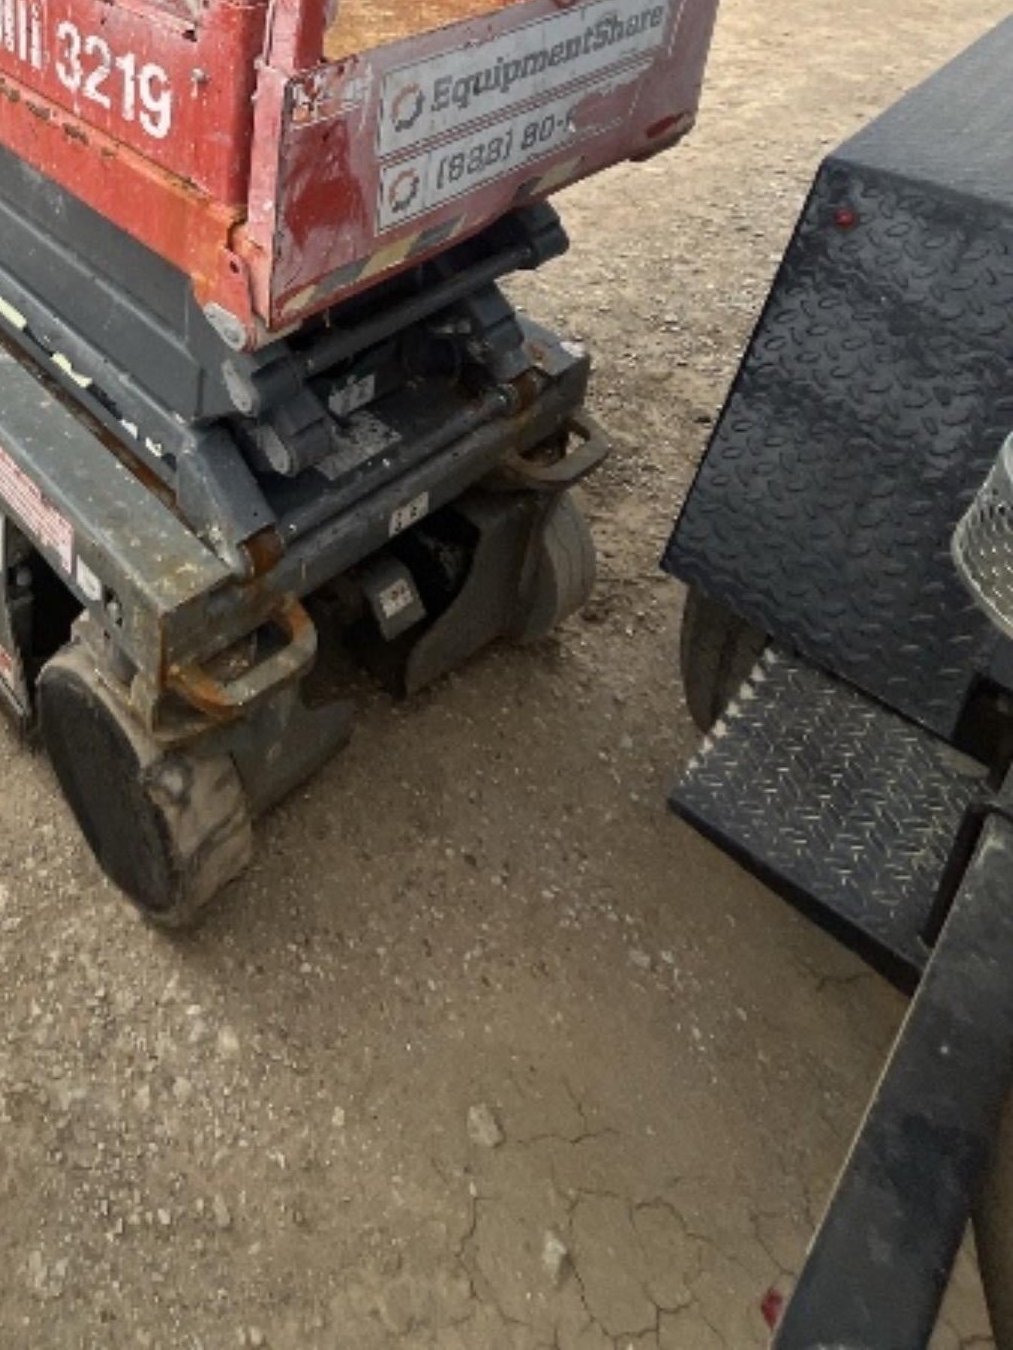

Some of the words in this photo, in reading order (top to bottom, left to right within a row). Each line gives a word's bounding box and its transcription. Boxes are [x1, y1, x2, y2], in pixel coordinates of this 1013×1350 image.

[56, 21, 173, 139] 3219
[430, 5, 665, 113] EquipmentShare
[437, 127, 514, 190] (888)
